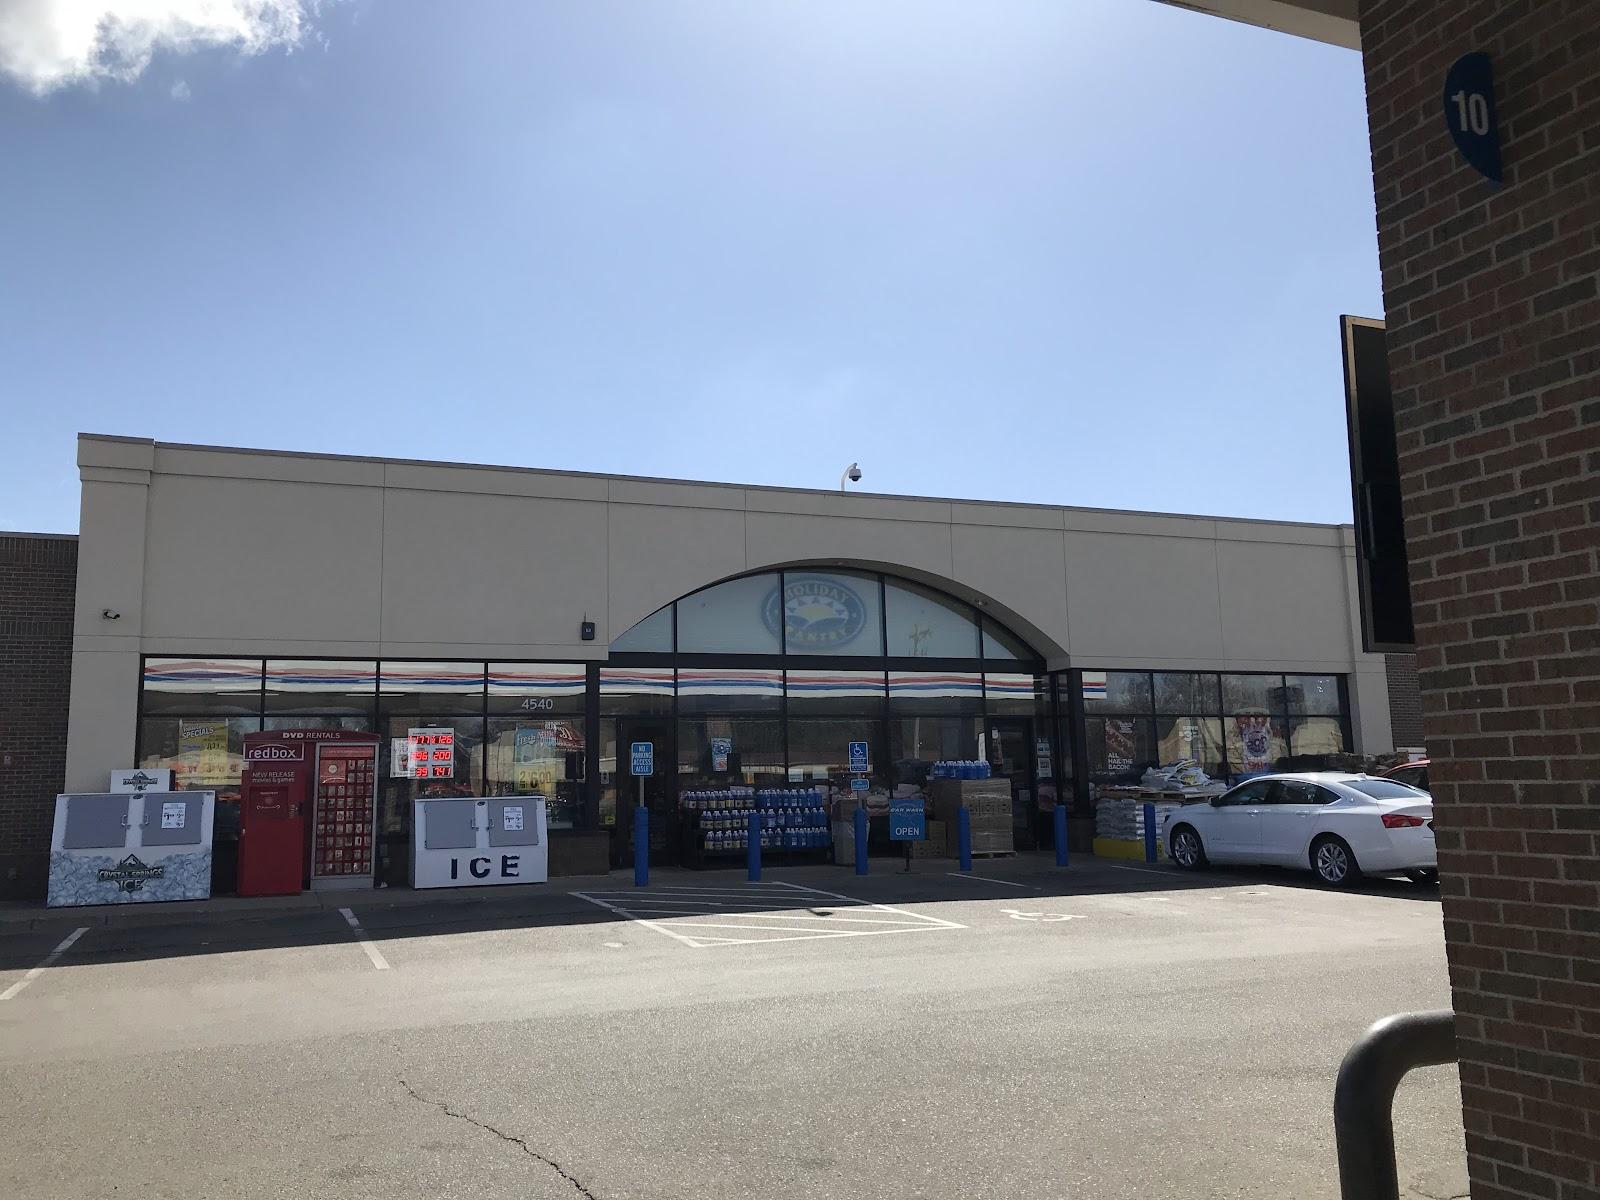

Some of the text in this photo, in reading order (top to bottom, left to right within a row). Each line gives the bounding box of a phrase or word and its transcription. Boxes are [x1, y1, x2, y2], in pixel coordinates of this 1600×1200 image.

[1451, 90, 1489, 136] 10
[521, 699, 554, 710] 4540
[182, 726, 214, 740] SPECIALS
[248, 747, 296, 759] redbox
[433, 751, 451, 760] 200
[895, 827, 920, 836] OPEN
[451, 855, 520, 879] ICE
[99, 868, 163, 879] CRYSTAL SPRINGS
[119, 879, 142, 890] ICE
